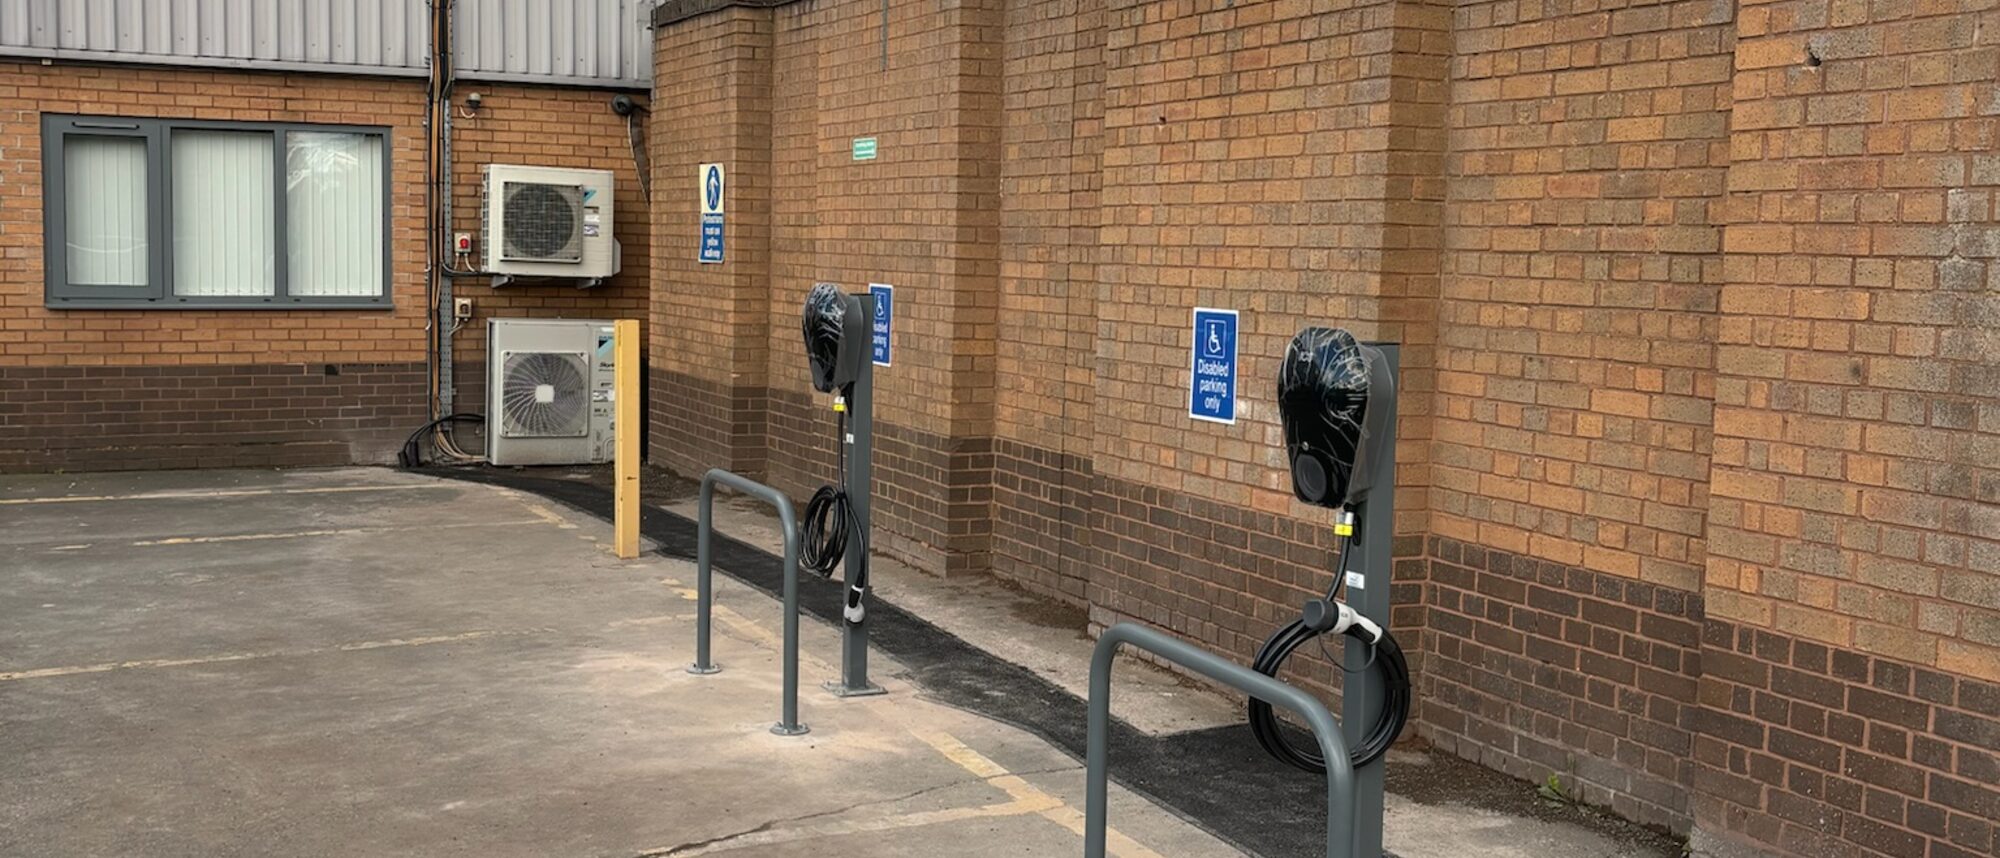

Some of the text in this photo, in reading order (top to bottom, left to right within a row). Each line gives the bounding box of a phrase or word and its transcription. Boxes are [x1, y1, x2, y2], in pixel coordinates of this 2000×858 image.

[1198, 359, 1229, 377] Disabled
[1199, 377, 1227, 398] parking
[1204, 395, 1221, 413] only
